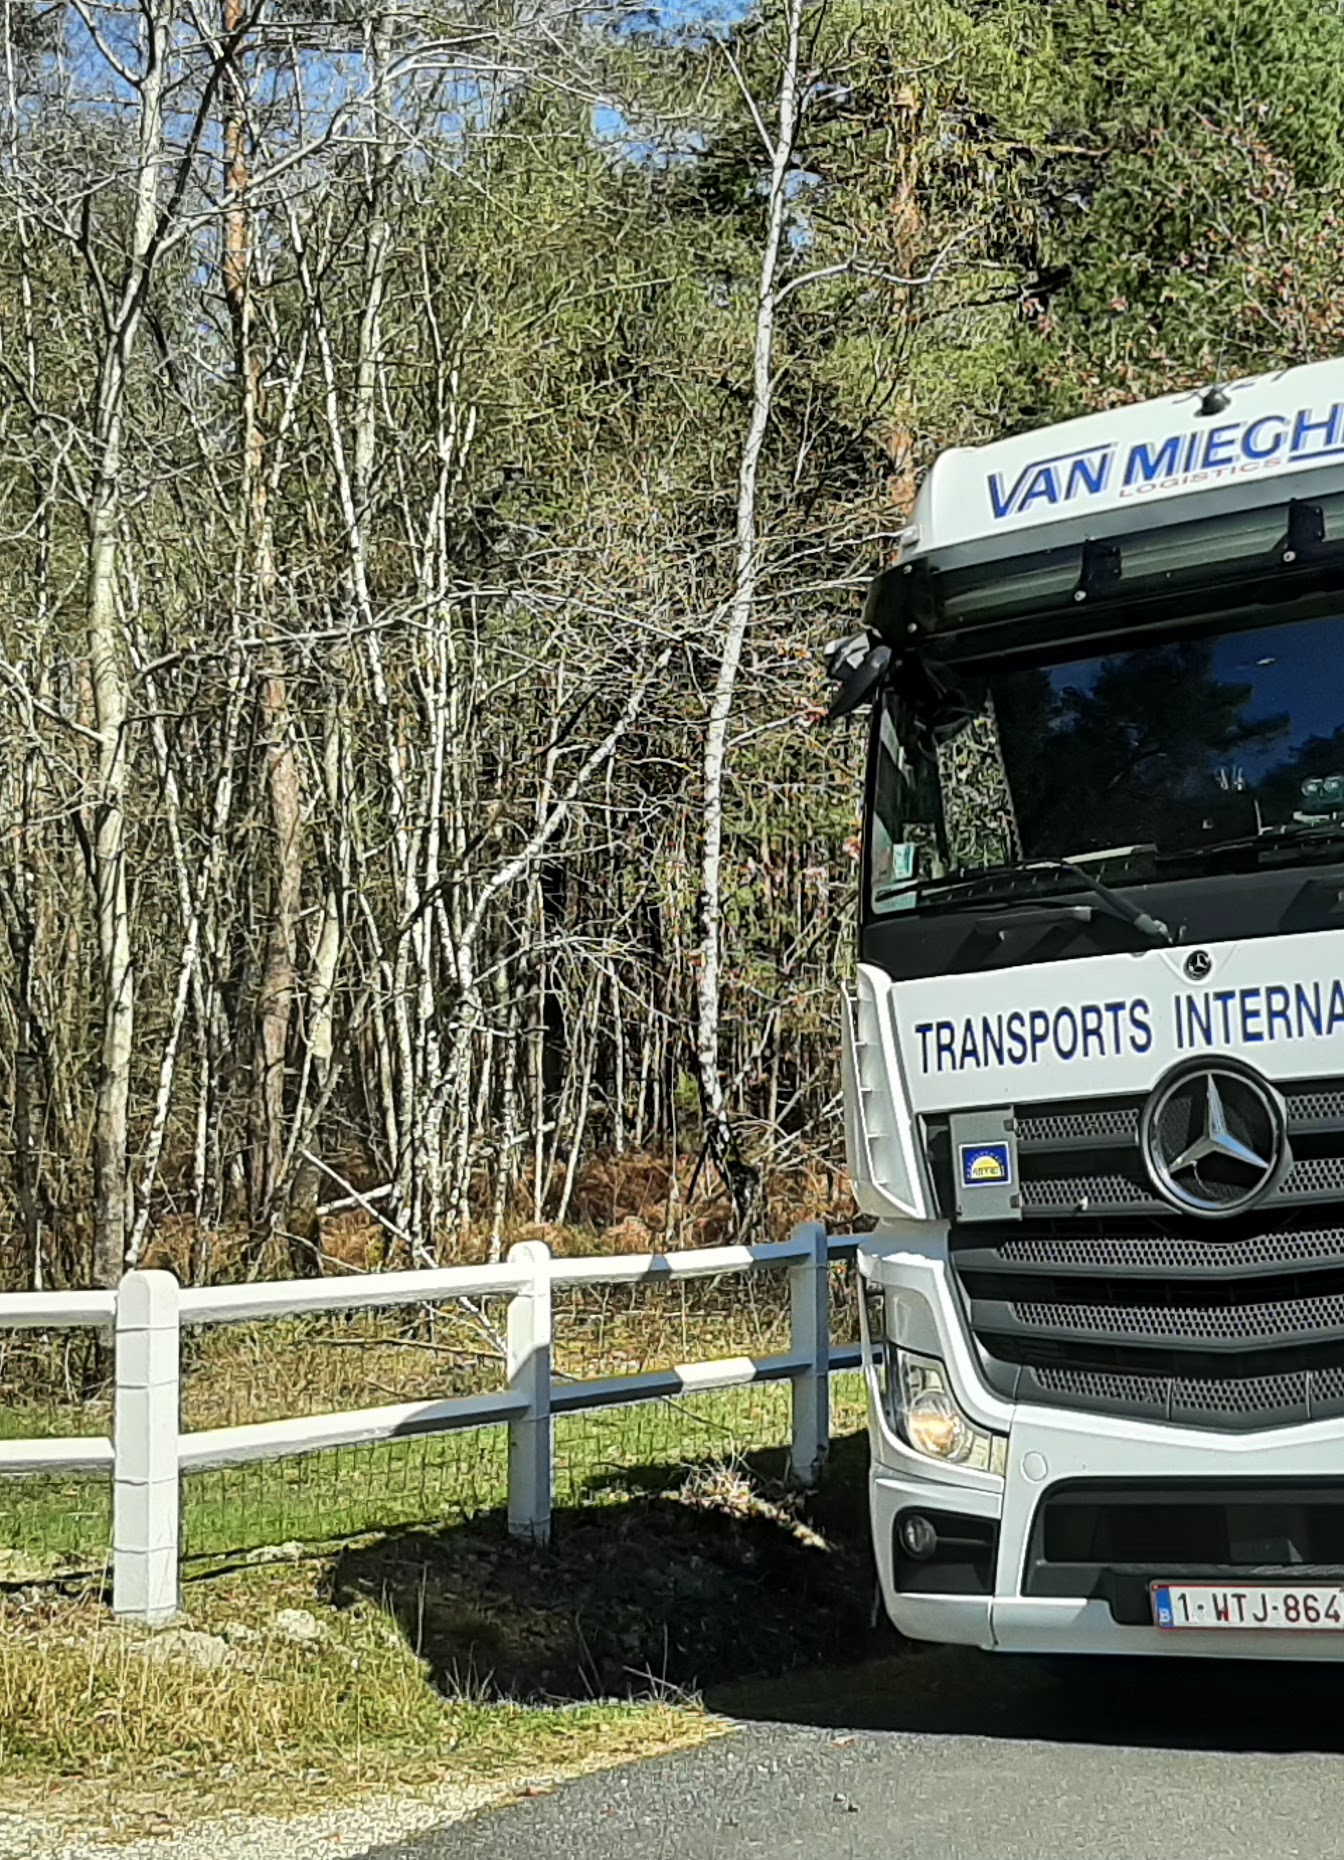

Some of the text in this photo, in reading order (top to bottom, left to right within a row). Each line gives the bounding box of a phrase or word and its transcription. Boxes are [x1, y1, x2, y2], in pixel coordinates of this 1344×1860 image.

[987, 442, 1118, 519] VAN
[1119, 457, 1282, 498] LOGISTICS
[915, 998, 1153, 1075] TRANSPORTS
[1159, 1608, 1172, 1623] B
[1177, 1592, 1341, 1623] 1-WTJ-864
